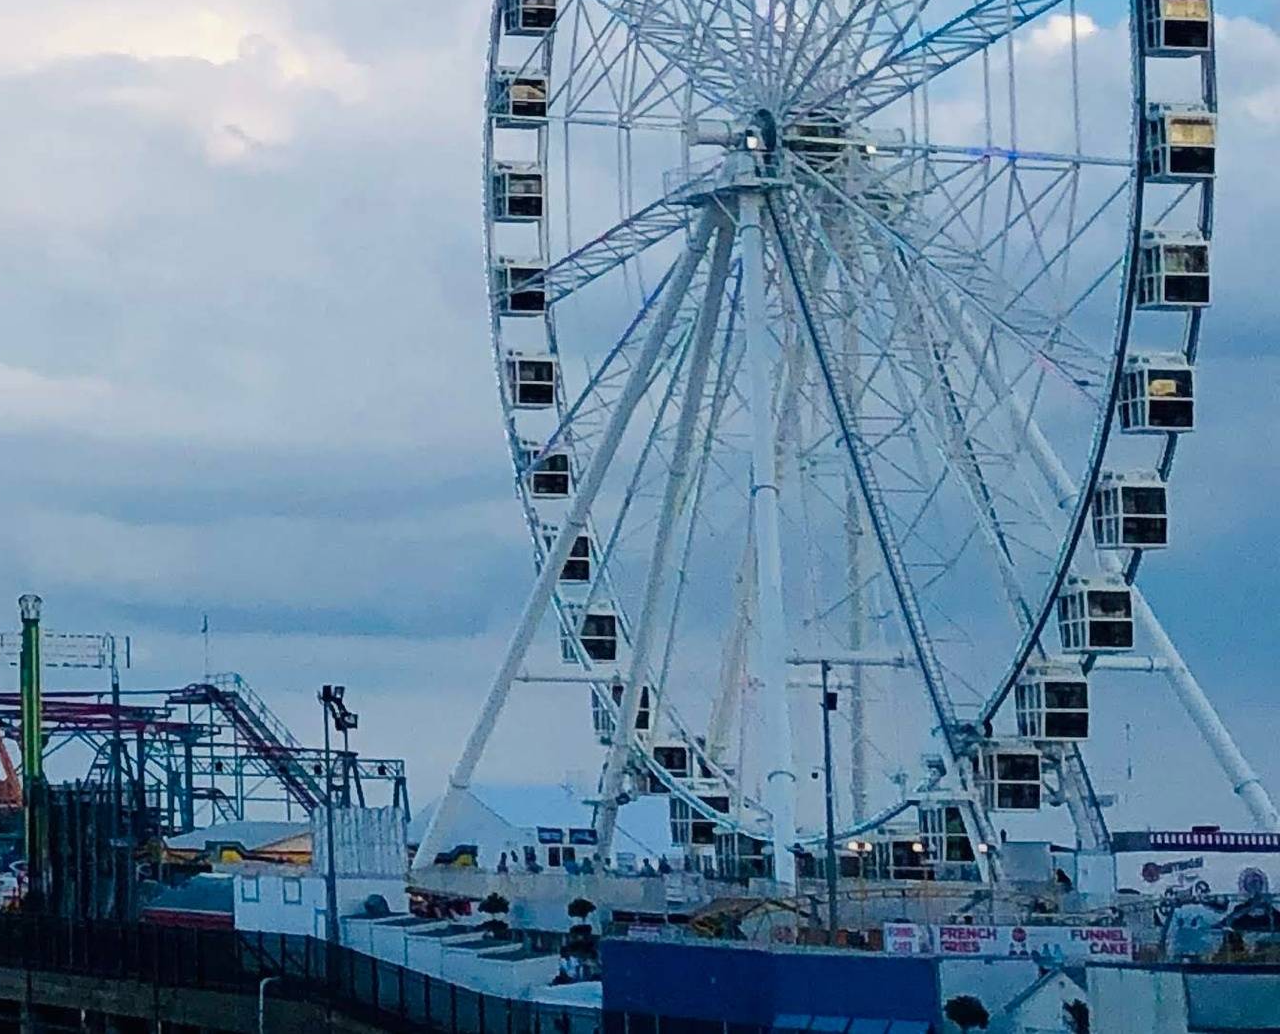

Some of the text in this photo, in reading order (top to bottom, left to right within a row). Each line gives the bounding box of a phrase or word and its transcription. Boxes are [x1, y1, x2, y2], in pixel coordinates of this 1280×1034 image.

[940, 927, 998, 941] FRENCH
[1070, 929, 1128, 942] FUNNEL
[1089, 942, 1128, 955] CAKE
